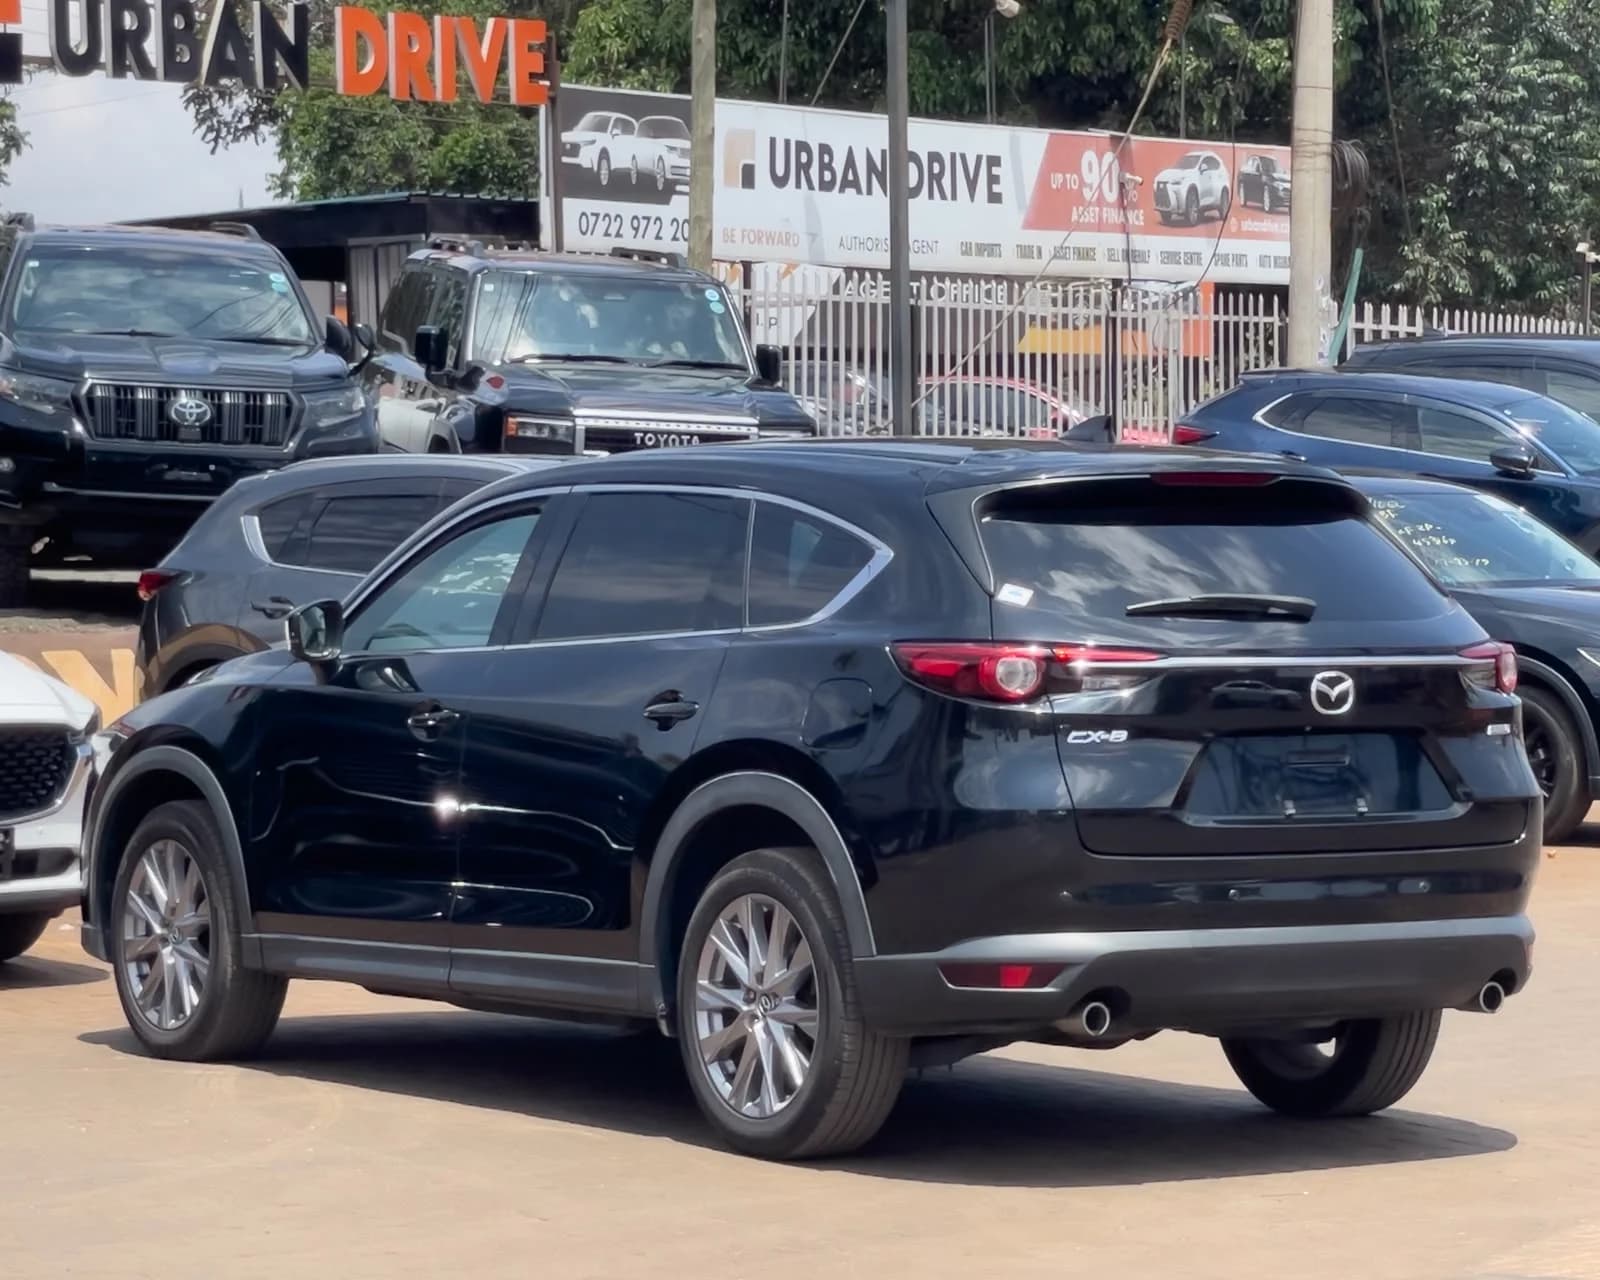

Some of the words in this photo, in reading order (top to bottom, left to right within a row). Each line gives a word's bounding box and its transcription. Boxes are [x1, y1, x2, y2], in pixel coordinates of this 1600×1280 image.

[49, 0, 309, 90] URBAN
[334, 6, 548, 106] DRIVE
[769, 136, 888, 197] URBAN
[907, 150, 1003, 204] DRIVE
[1050, 173, 1064, 190] UP
[1065, 174, 1079, 190] TO
[1071, 206, 1099, 225] ASSET
[1102, 207, 1144, 226] FINANCE
[578, 211, 623, 239] 0722
[630, 215, 663, 241] 972
[670, 218, 689, 242] 20
[722, 227, 736, 244] BE
[740, 229, 800, 247] FORWARD
[838, 235, 890, 253] AUTHORIS
[844, 280, 921, 300] AGET
[929, 280, 1007, 304] OFFICE
[634, 432, 700, 448] TOYOTA
